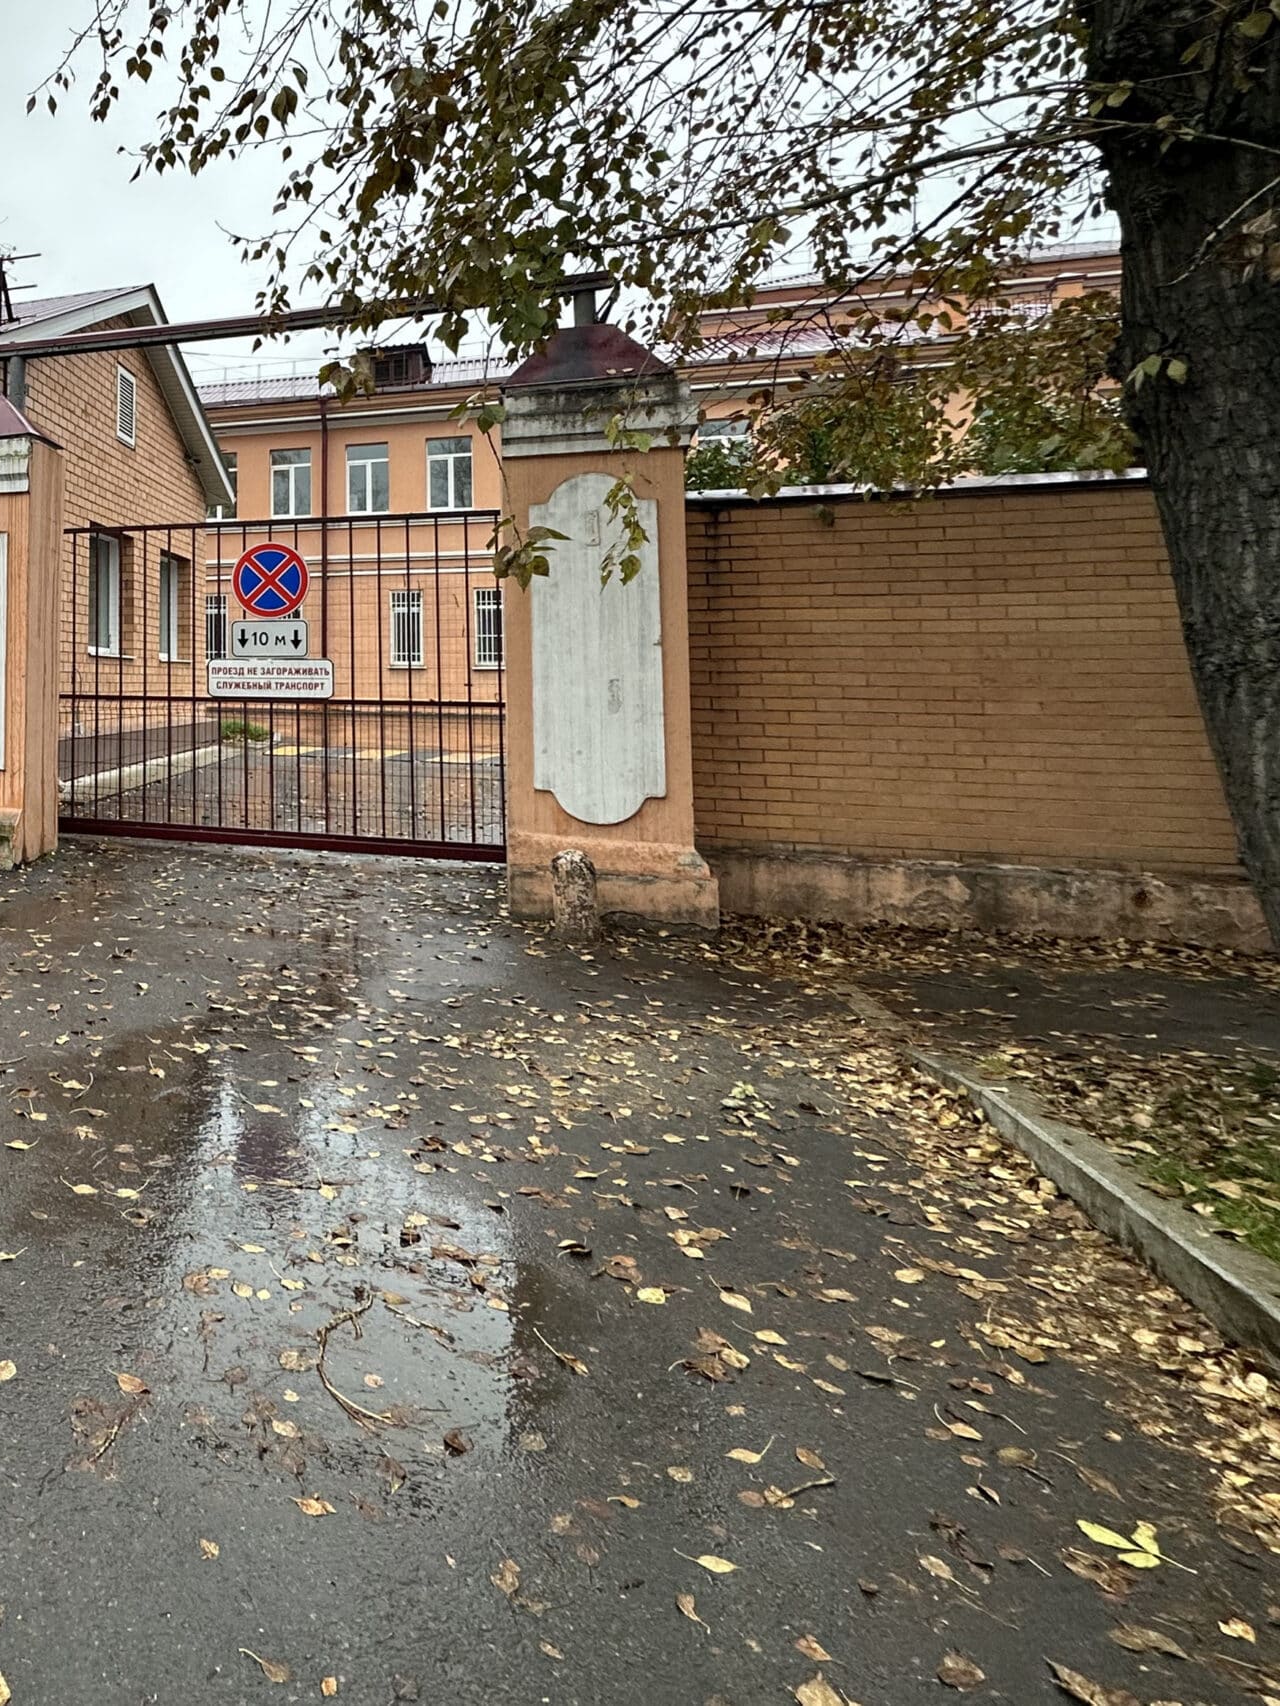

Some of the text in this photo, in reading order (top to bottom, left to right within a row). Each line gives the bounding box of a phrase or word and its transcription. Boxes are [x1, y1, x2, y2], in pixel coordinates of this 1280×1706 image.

[251, 632, 269, 646] 10
[211, 667, 330, 676] ПРОЕЗД НЕ ЗАГОРАЖИВАТЬ
[216, 681, 325, 691] СЛУЖЕБНЫЙ ТРАНСПОРТ
